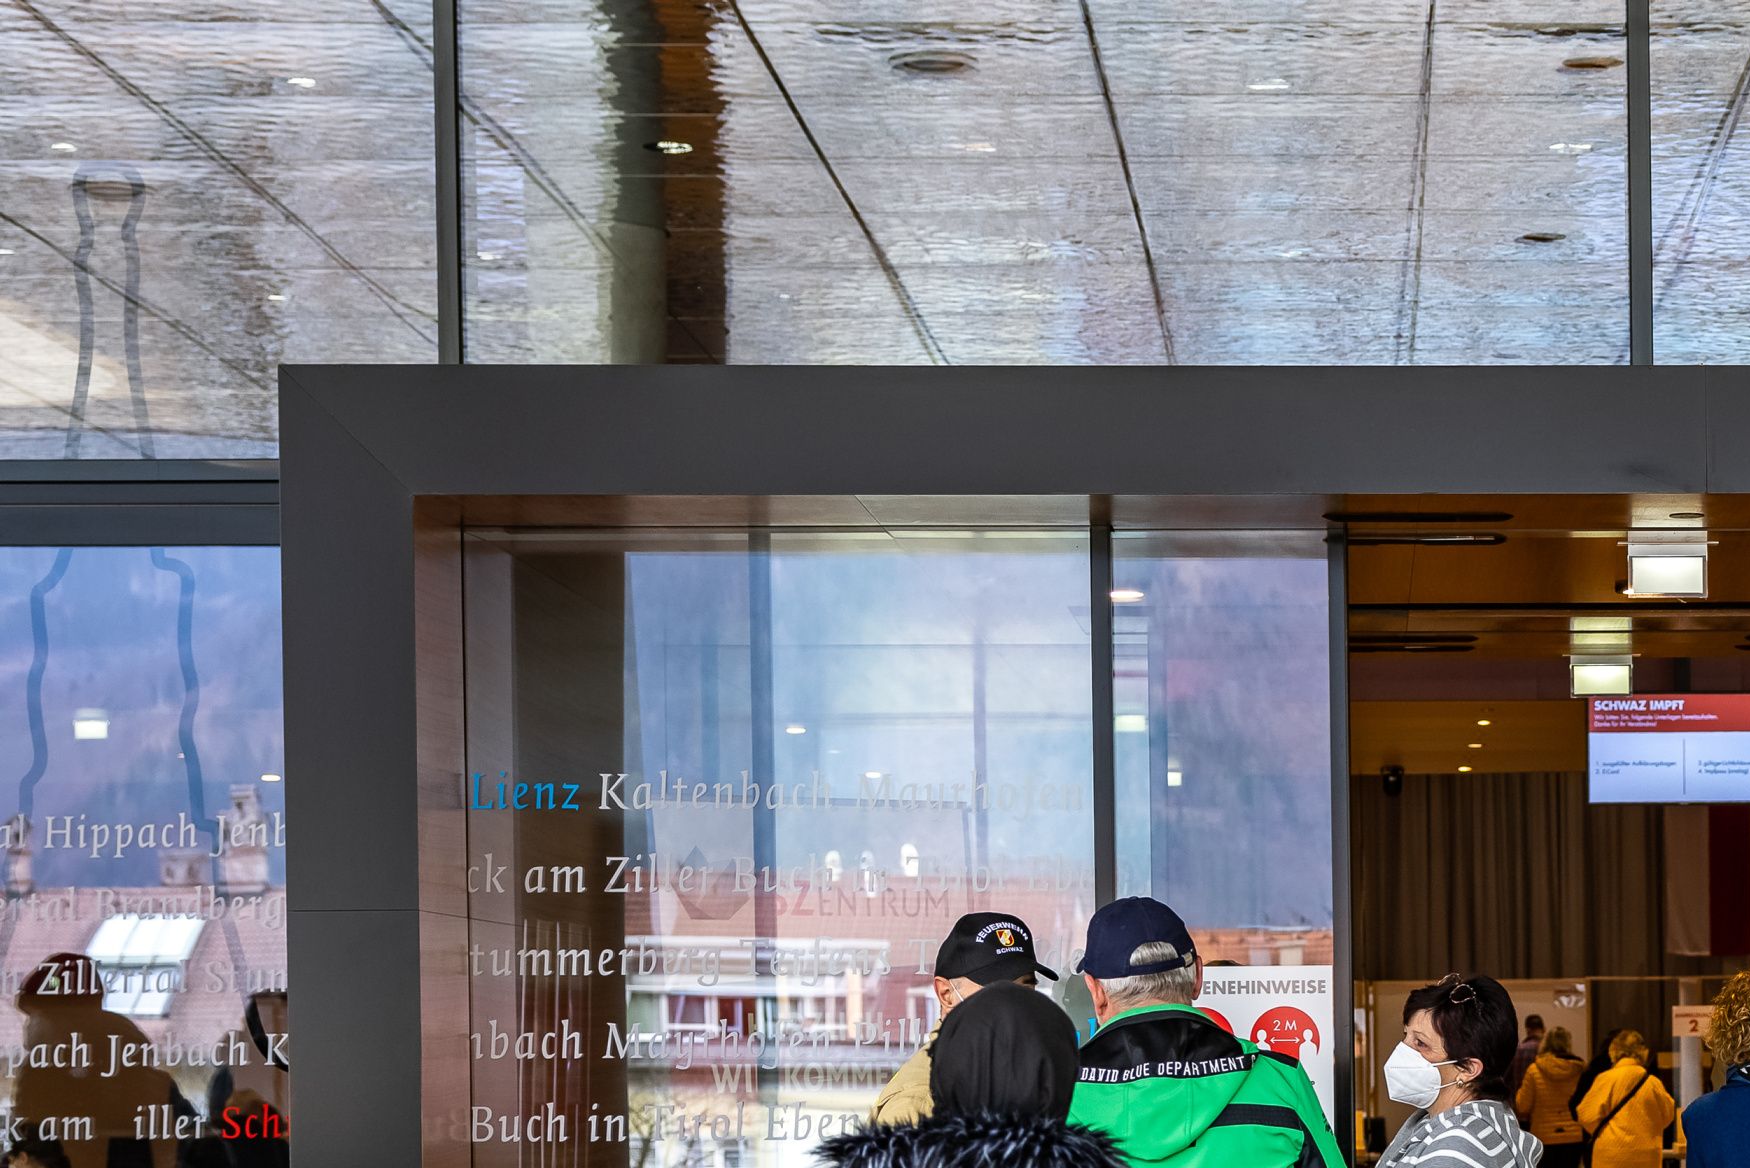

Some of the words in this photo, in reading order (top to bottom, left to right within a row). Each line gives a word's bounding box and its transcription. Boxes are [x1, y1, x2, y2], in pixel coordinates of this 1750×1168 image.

[1594, 700, 1647, 711] SCHWAZ
[1650, 700, 1684, 711] IMPFT
[471, 771, 580, 811] Lienz
[598, 769, 832, 811] Kaltenbach
[856, 768, 1083, 821] Mayrhofen
[44, 813, 197, 859] Hippach
[524, 864, 586, 893] am
[604, 852, 712, 893] Ziller
[732, 853, 834, 893] Buch
[95, 885, 285, 930] Brandberg
[738, 936, 892, 987] Terfens
[996, 946, 1024, 955] SCHWAZ
[37, 959, 188, 995] Zillertal
[1202, 979, 1327, 995] ENEHINWEISE
[601, 1018, 831, 1070] Mayrhofen
[1273, 1020, 1282, 1031] 2
[1284, 1020, 1298, 1031] M
[1688, 1019, 1699, 1032] 2
[101, 1030, 249, 1078] Jenbach
[1080, 1066, 1119, 1083] DAVID
[1122, 1062, 1151, 1081] BLUE
[1157, 1055, 1246, 1078] DEPARTMENT
[38, 1115, 94, 1142] am
[471, 1101, 568, 1143] Buch
[588, 1103, 627, 1143] in
[644, 1101, 746, 1142] Tirol
